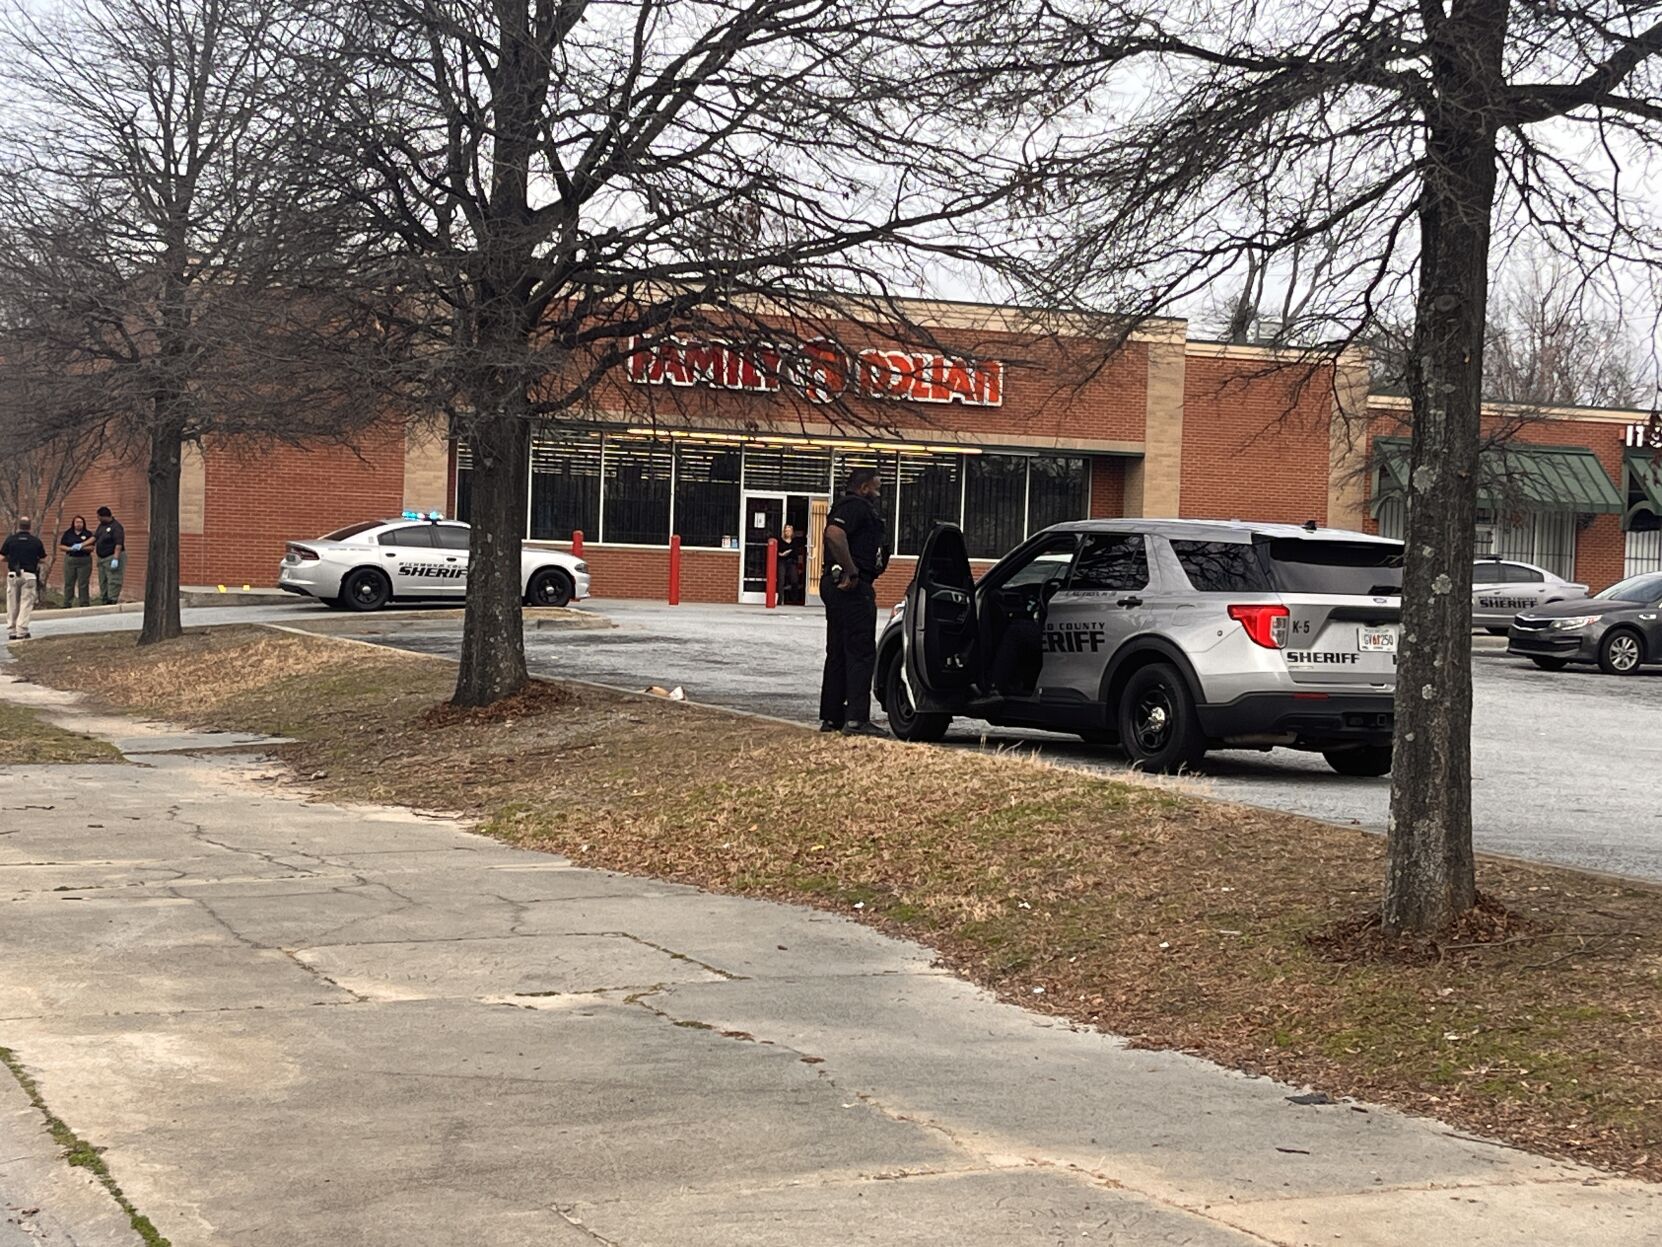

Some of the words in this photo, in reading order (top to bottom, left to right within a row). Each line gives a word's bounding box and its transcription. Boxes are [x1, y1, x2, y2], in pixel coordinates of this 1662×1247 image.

[398, 566, 469, 578] SHERIF
[1480, 600, 1538, 608] SHERIFF
[1059, 622, 1105, 631] COUNTY
[1292, 620, 1310, 634] K-5
[1286, 651, 1360, 664] SHERIFF
